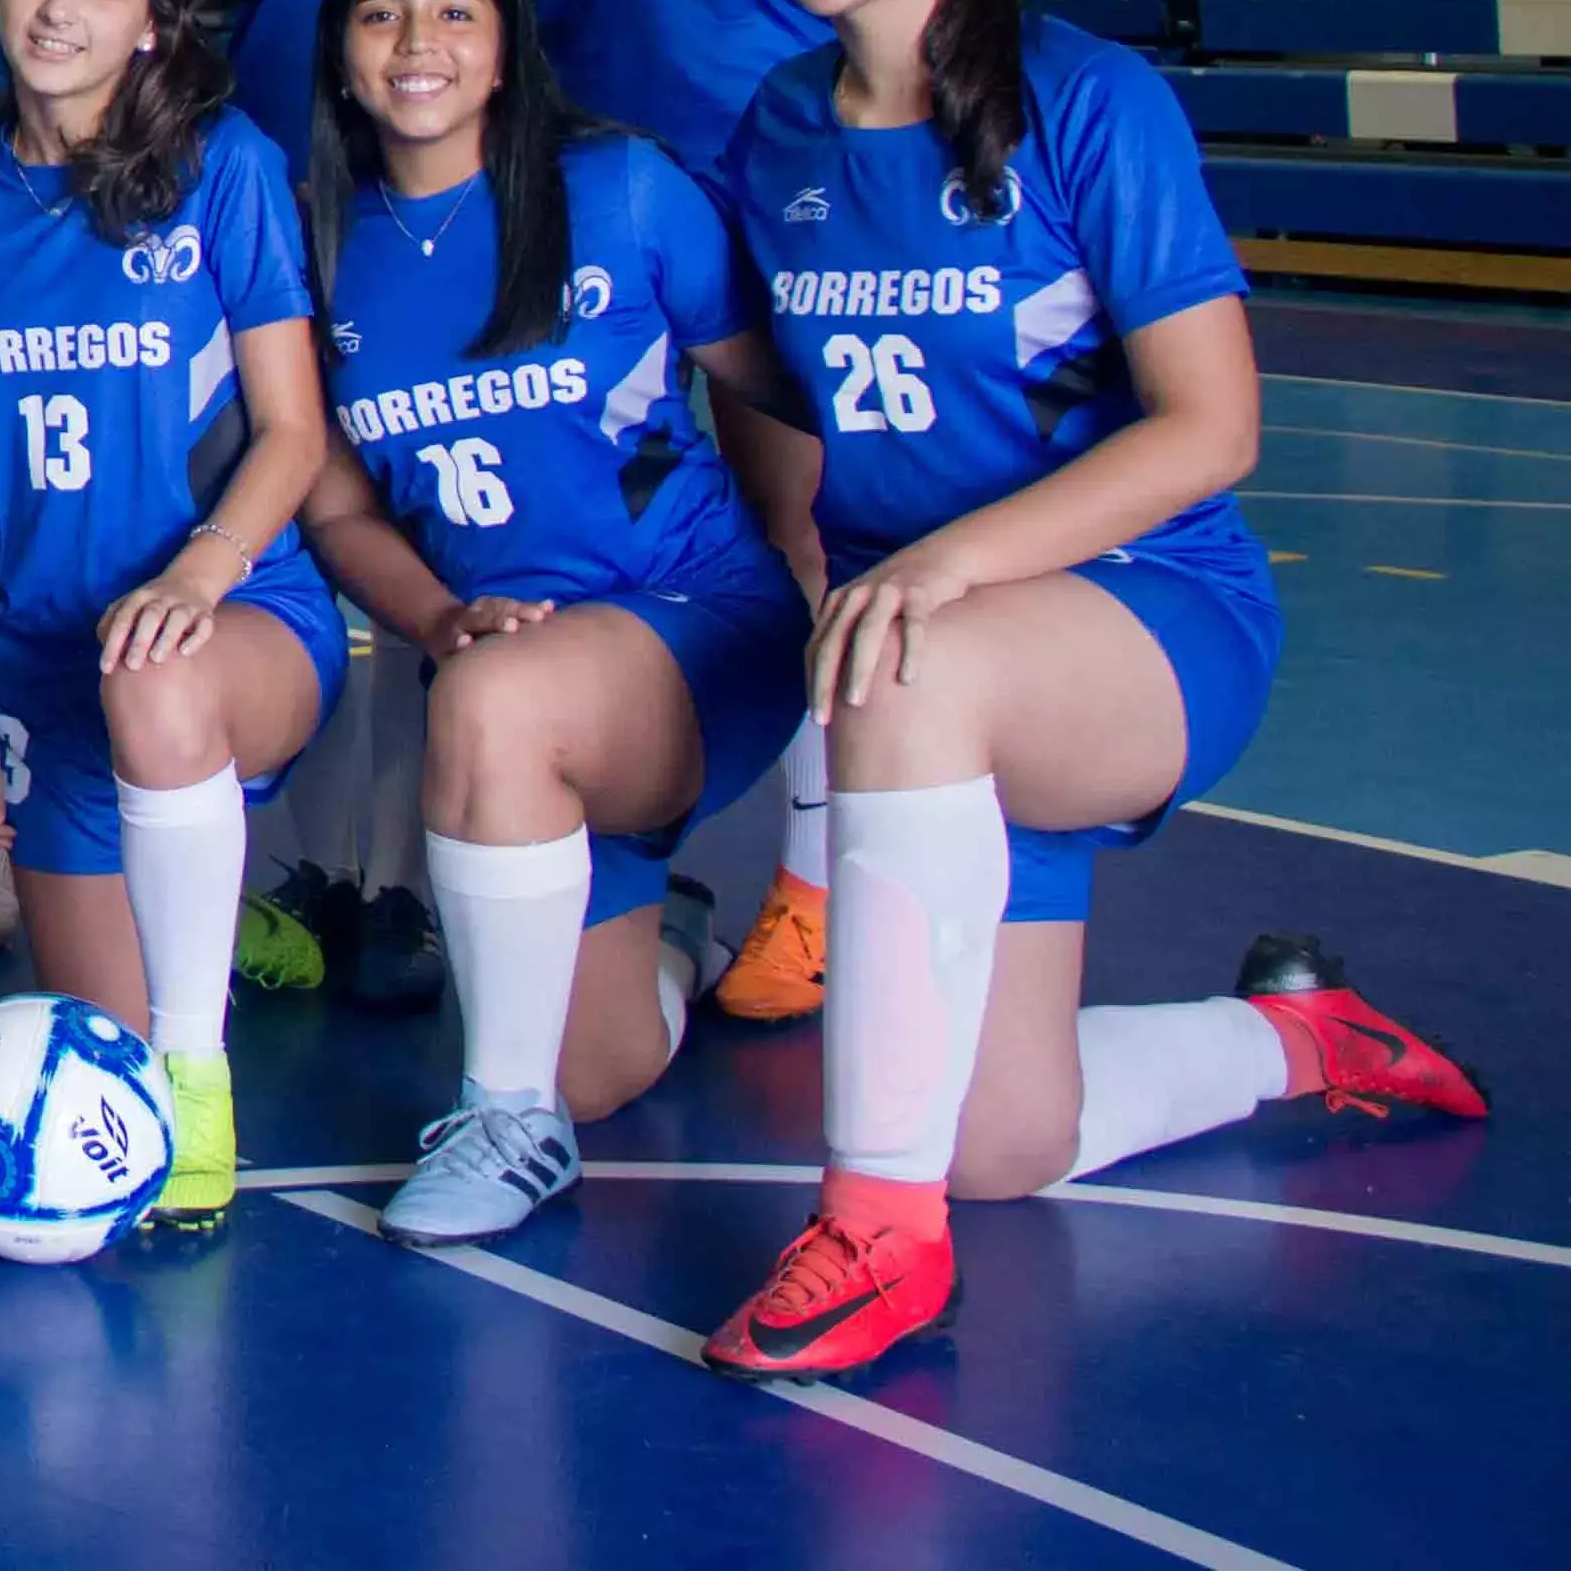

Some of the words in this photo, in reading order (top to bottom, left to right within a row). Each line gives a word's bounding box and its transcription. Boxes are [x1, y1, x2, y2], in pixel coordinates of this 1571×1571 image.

[772, 265, 1002, 317] BORREGOS
[336, 358, 588, 445] BORREGOS
[822, 333, 938, 433] 26
[18, 394, 92, 491] 13
[416, 437, 515, 528] 16
